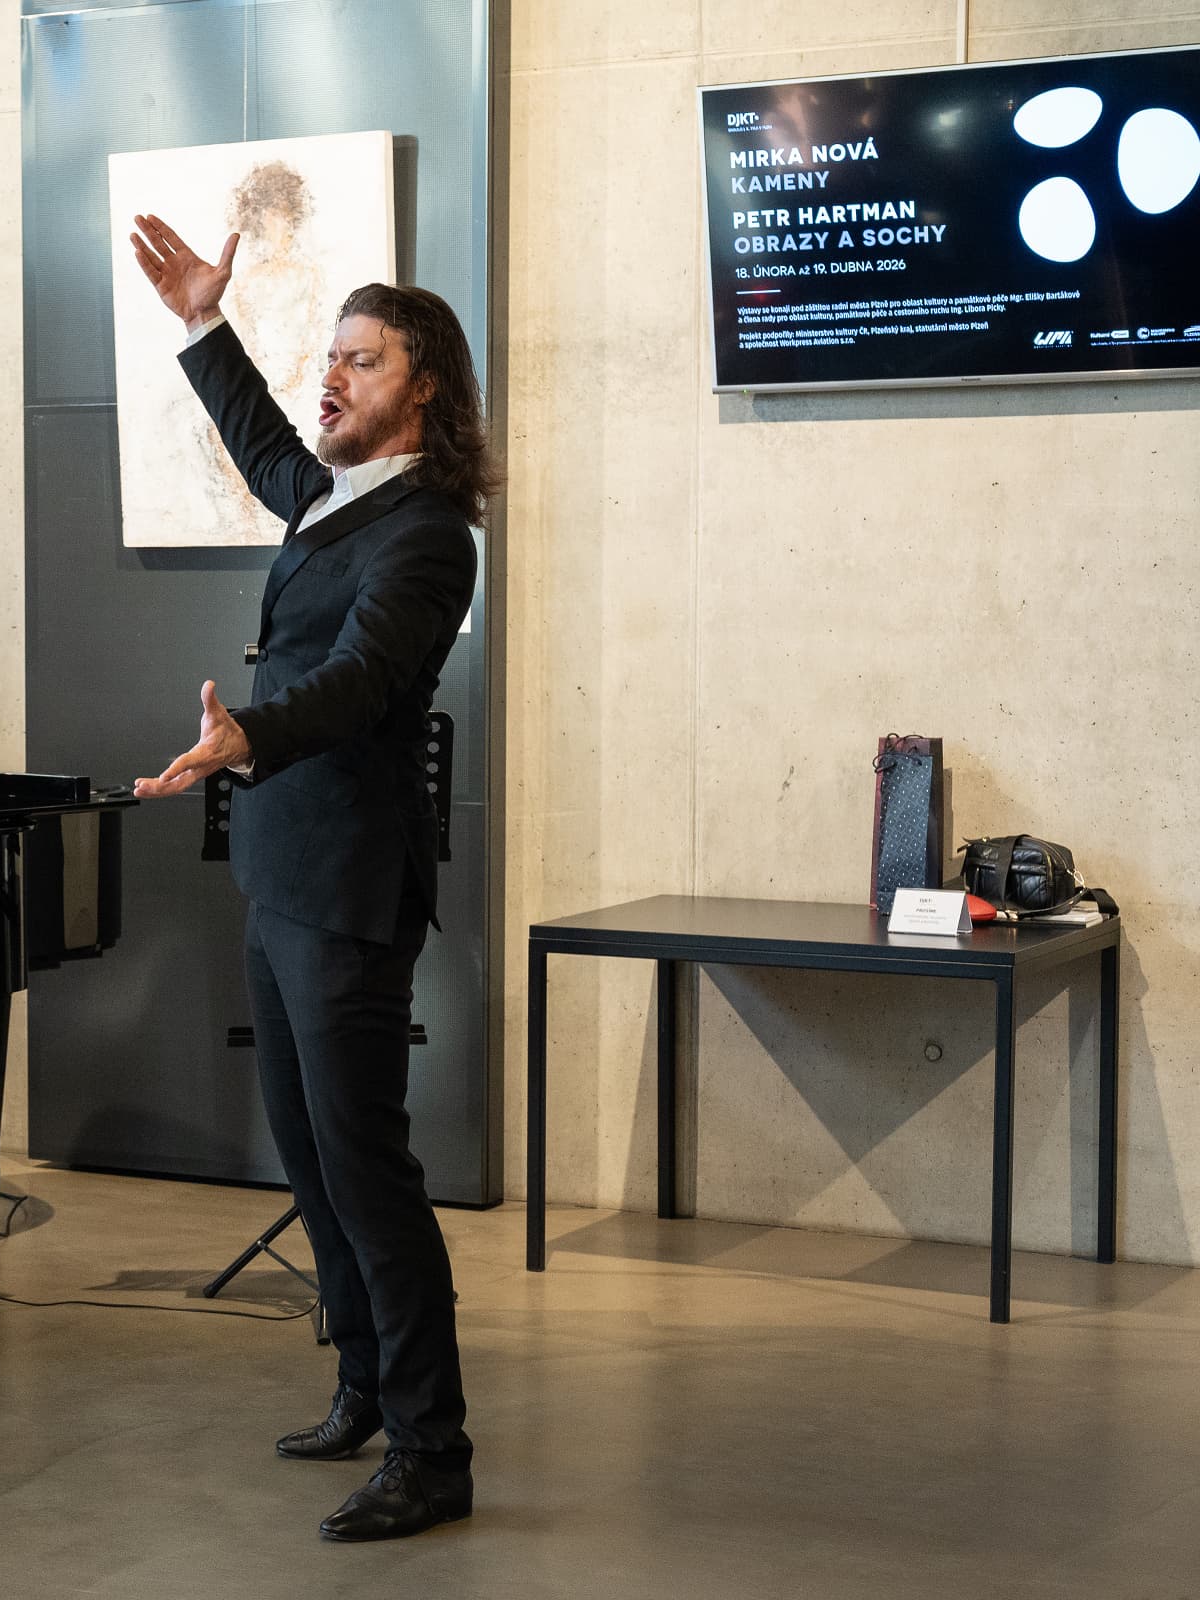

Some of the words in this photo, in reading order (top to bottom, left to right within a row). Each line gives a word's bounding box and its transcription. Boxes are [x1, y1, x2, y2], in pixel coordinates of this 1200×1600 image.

[730, 147, 804, 169] MIRKA
[811, 136, 879, 163] NOVÁ
[731, 170, 830, 194] KAMENY
[733, 209, 790, 229] PETR
[798, 200, 916, 225] HARTMAN
[734, 231, 829, 254] OBRAZY
[838, 230, 854, 248] A
[862, 224, 947, 247] SOCHY
[735, 267, 750, 279] 18.
[753, 264, 796, 278] ÚNORA
[813, 263, 828, 274] 19.
[830, 261, 874, 274] DUBNA
[876, 258, 907, 271] 2026
[791, 304, 803, 313] pod
[890, 301, 901, 309] pro
[902, 299, 923, 307] oblast
[777, 315, 788, 324] pro
[790, 313, 809, 321] oblast
